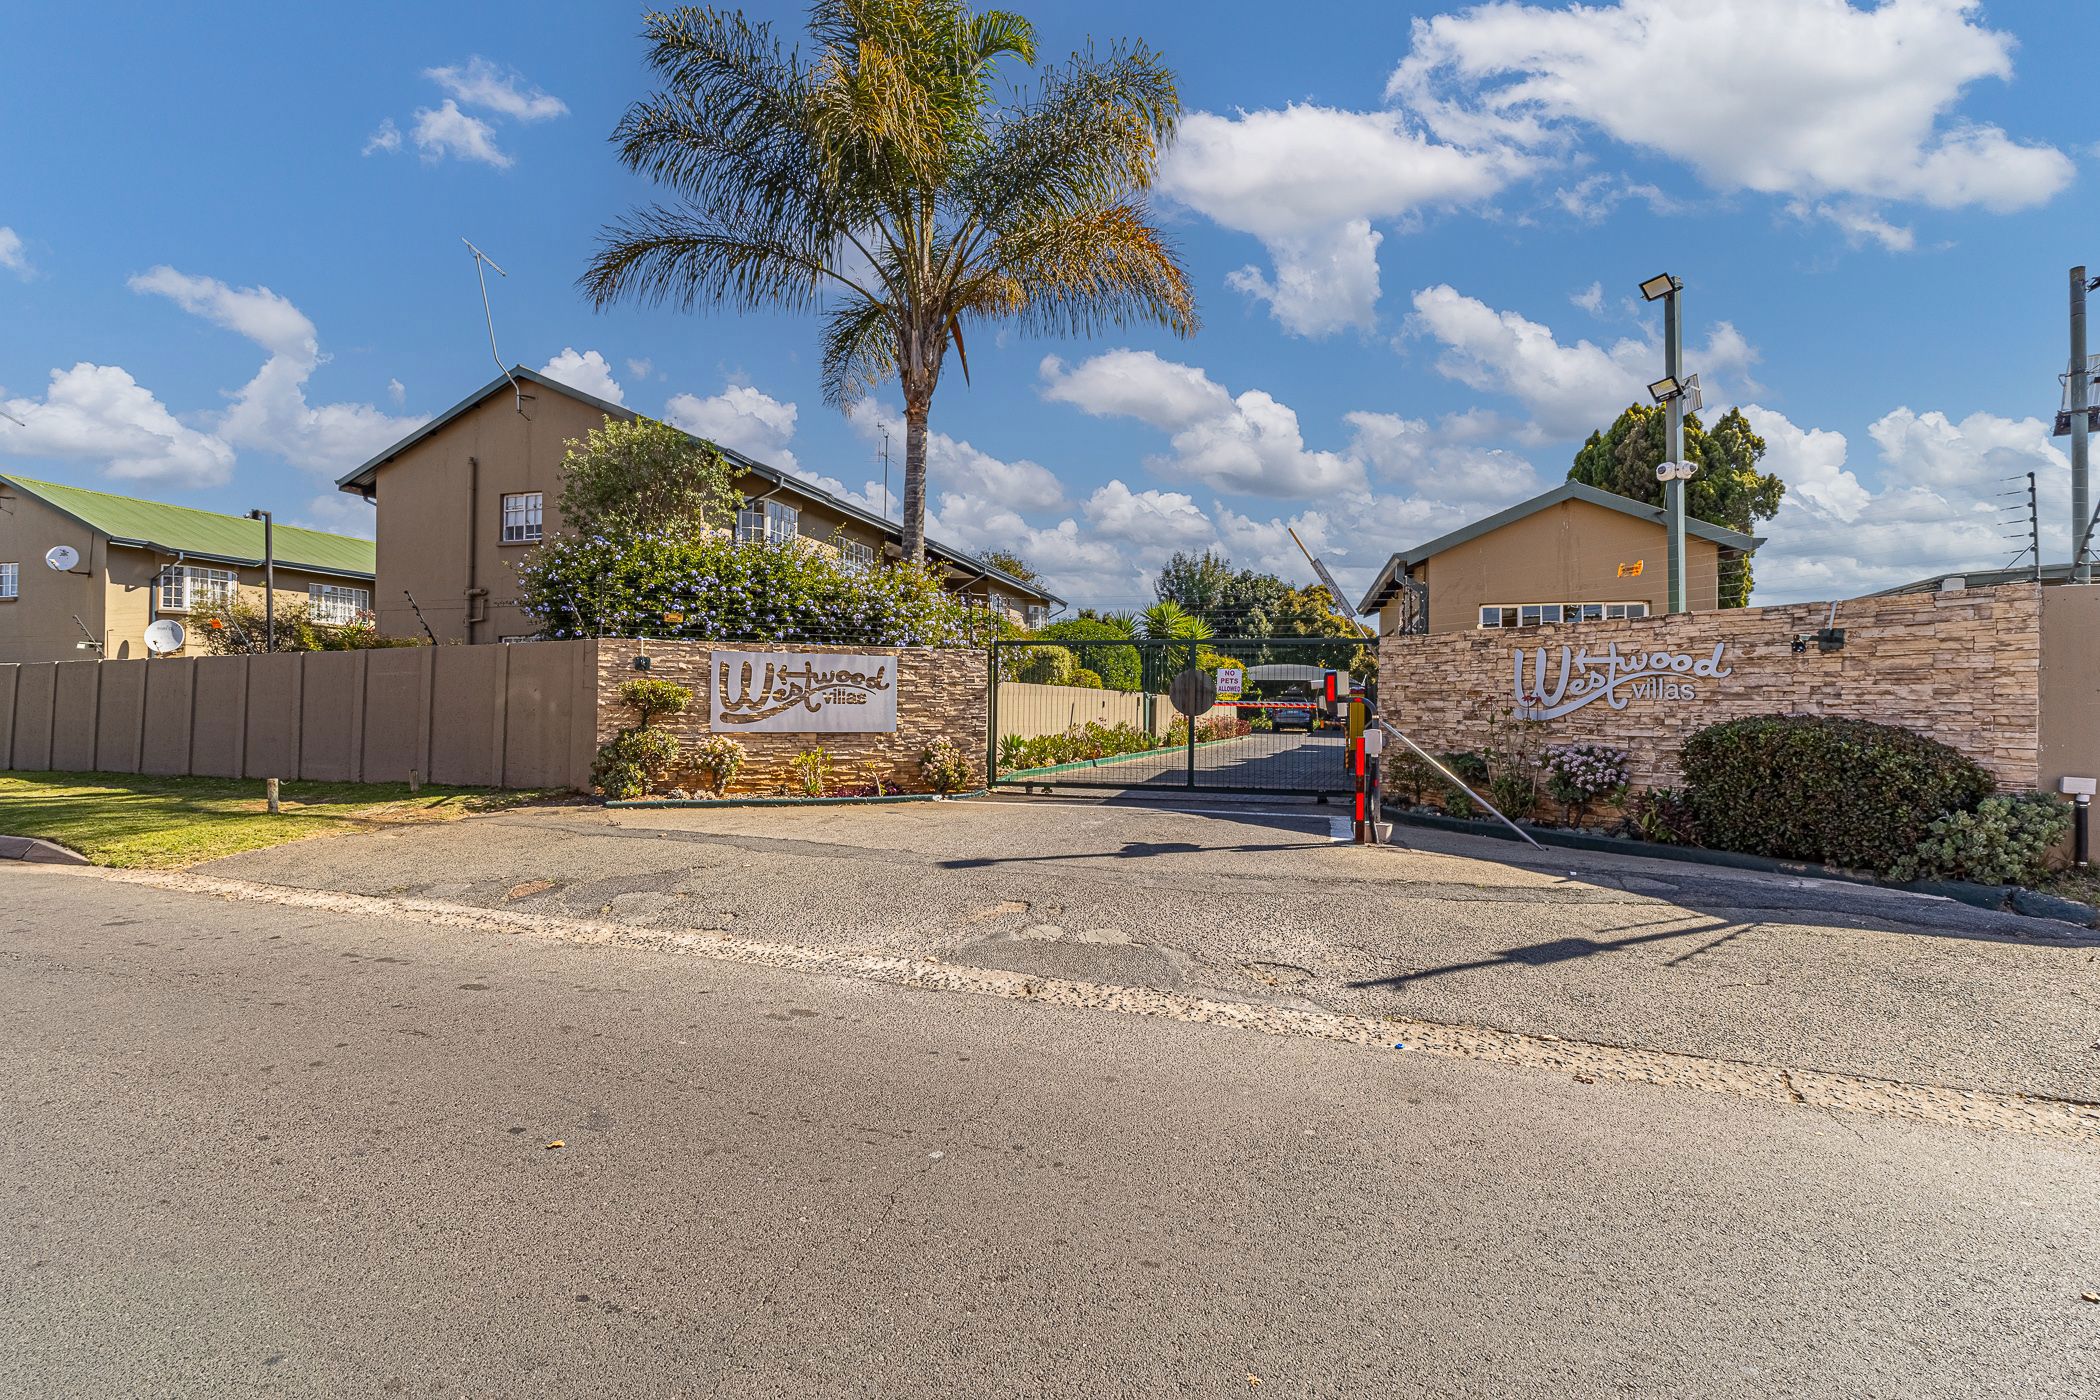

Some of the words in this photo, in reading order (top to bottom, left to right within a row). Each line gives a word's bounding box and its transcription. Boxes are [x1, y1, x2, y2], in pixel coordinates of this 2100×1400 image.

[719, 661, 889, 713] Westwood
[1514, 642, 1732, 710] Westwood
[1632, 677, 1695, 700] villas
[822, 688, 867, 705] villas
